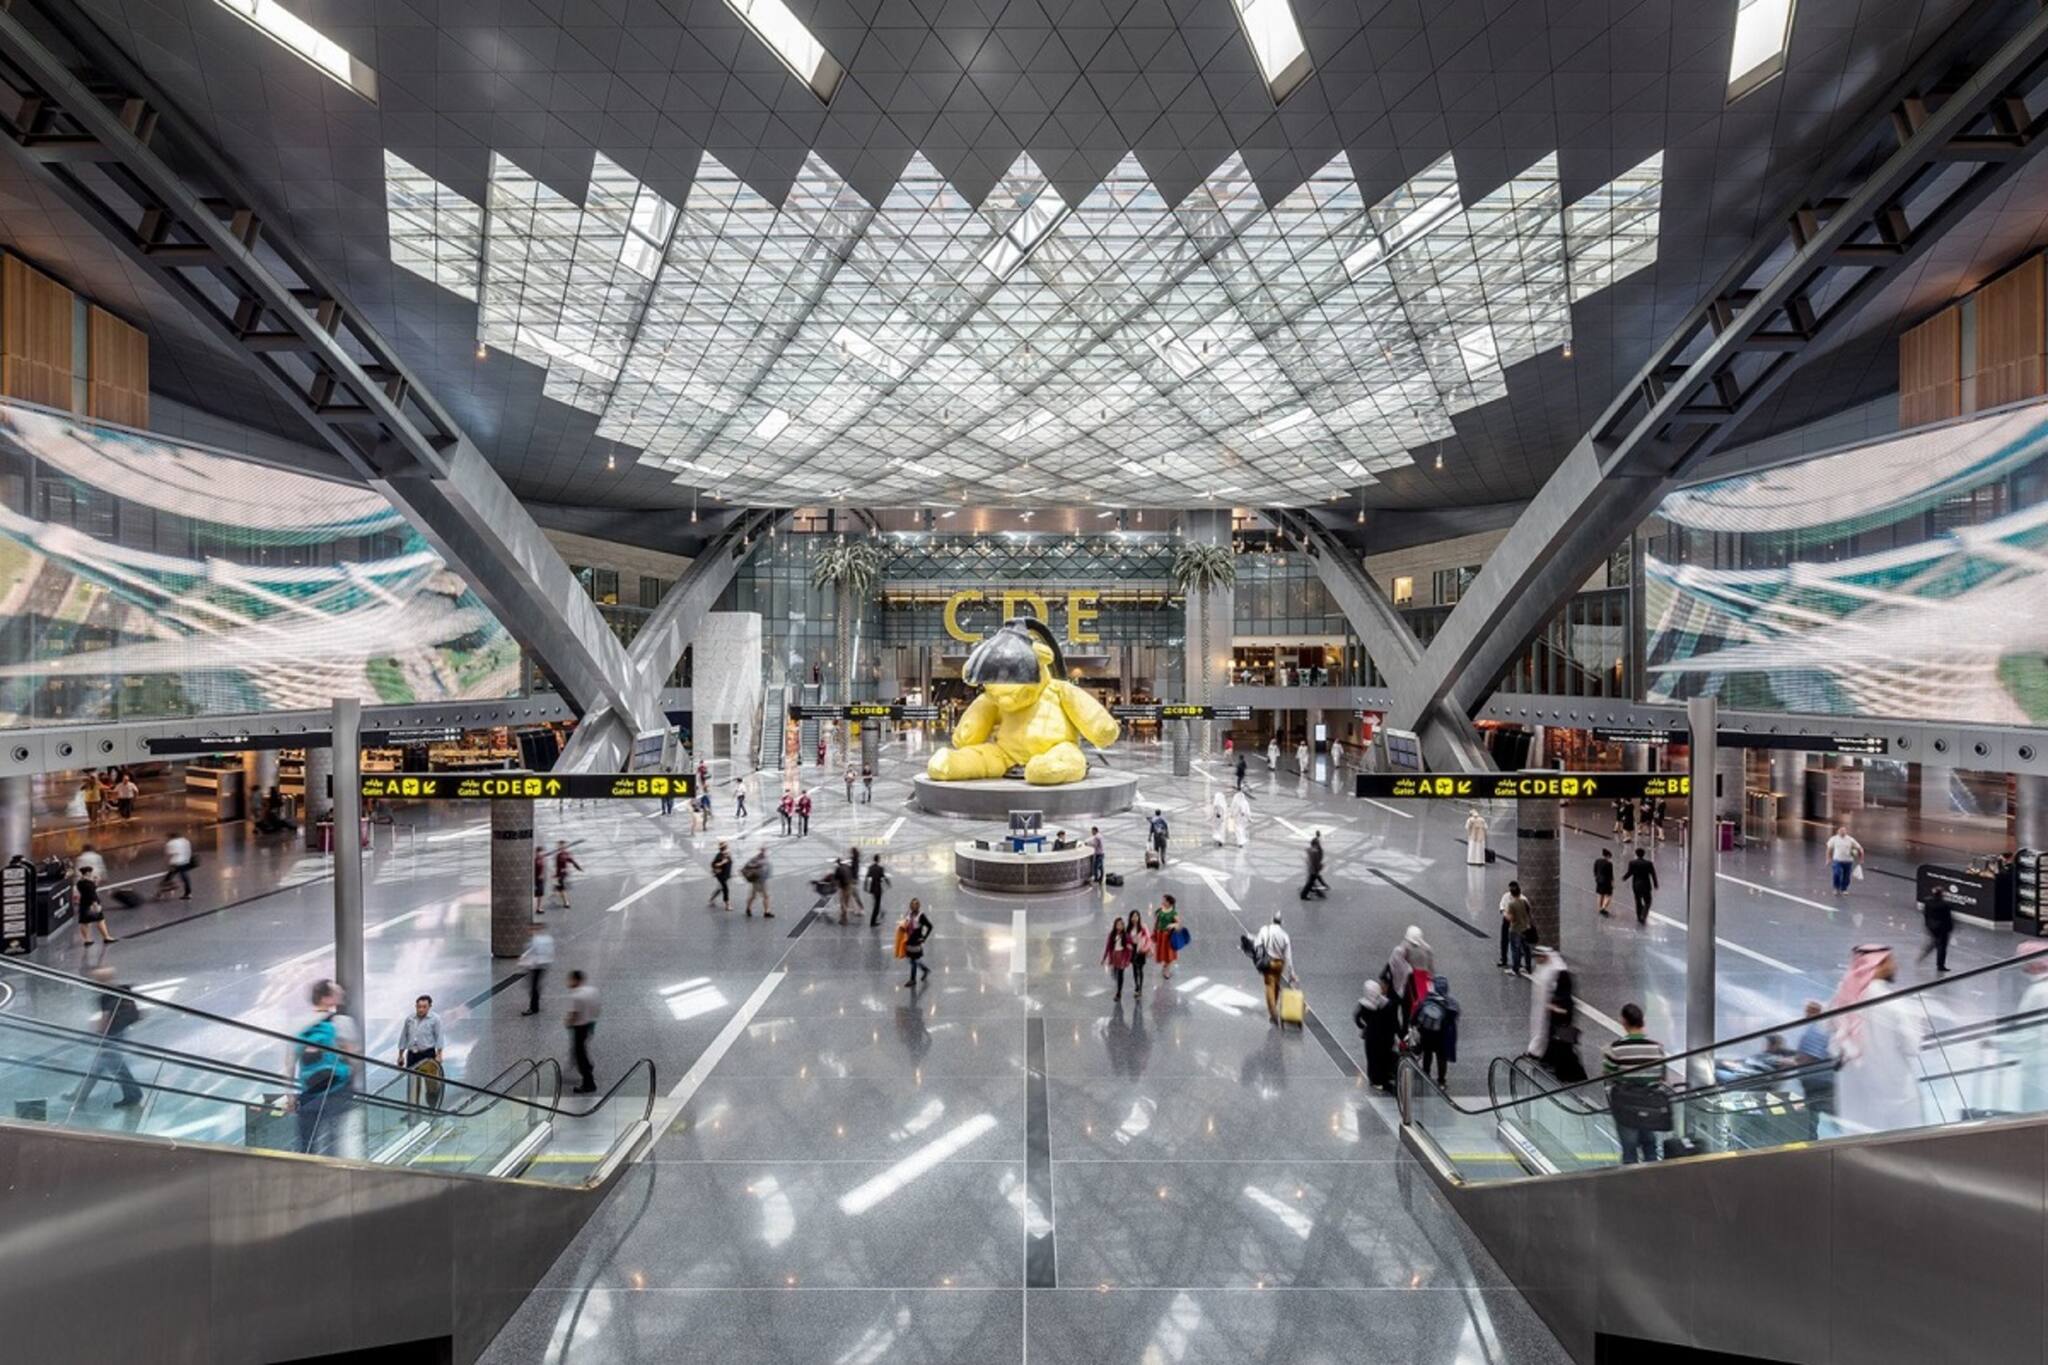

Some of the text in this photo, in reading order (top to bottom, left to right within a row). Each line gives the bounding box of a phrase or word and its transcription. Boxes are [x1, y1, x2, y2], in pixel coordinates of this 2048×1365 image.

[386, 779, 400, 795] A
[457, 787, 480, 796] Gates
[611, 787, 635, 796] Gates
[636, 778, 649, 794] B
[1392, 786, 1416, 796] Gates
[1418, 778, 1433, 794] A
[1494, 787, 1518, 796] Gates
[1667, 778, 1679, 794] B
